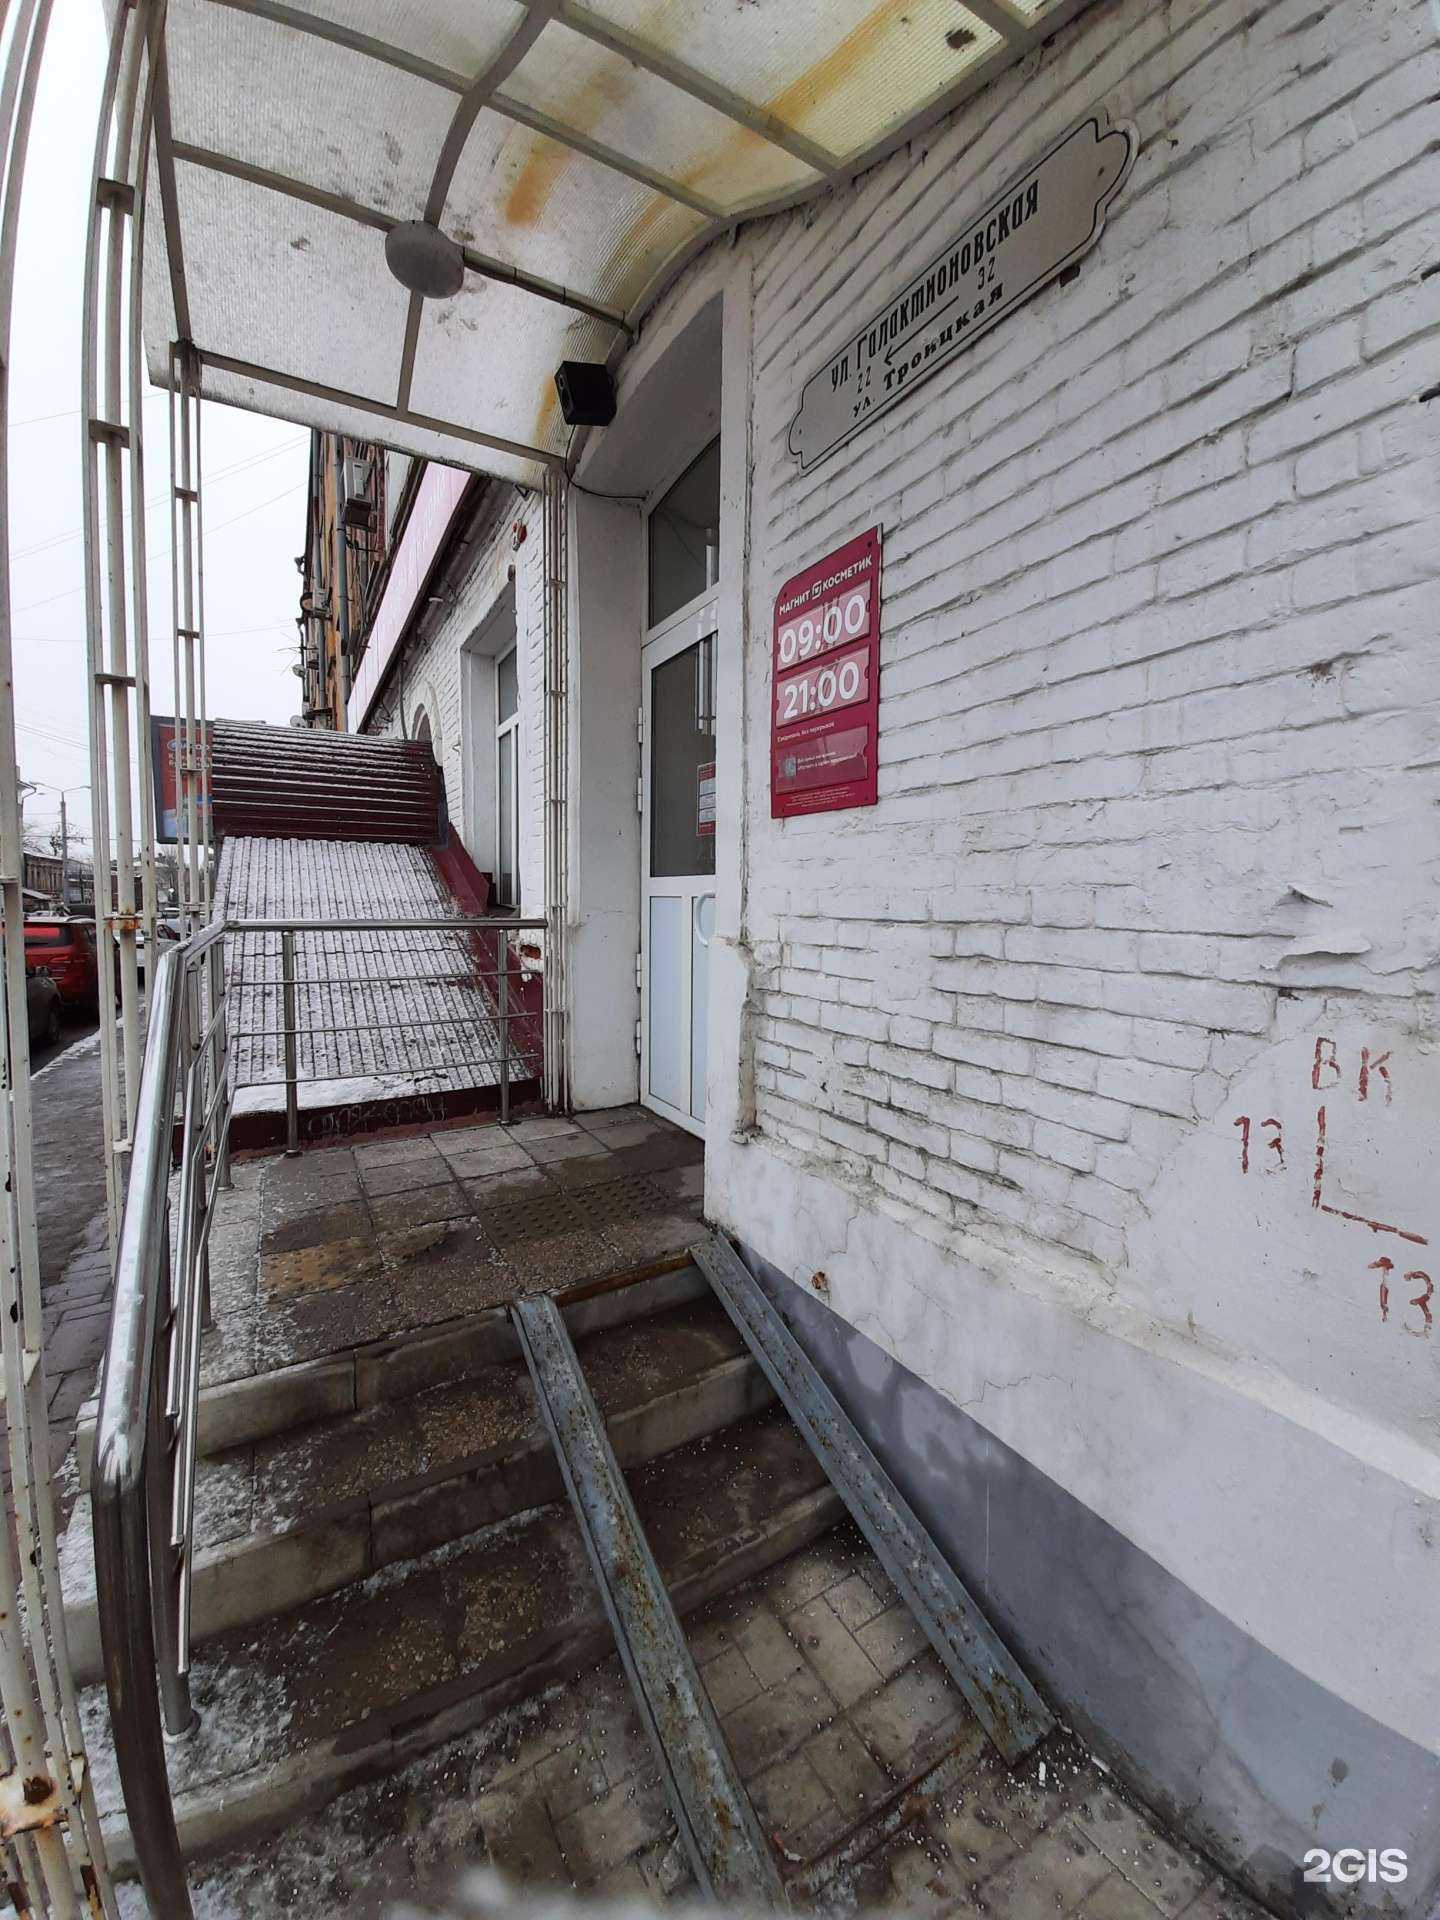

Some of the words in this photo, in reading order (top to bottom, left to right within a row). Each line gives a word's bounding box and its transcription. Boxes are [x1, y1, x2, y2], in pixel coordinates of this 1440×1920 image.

[857, 366, 871, 394] 22
[977, 257, 996, 290] 32
[883, 282, 1004, 392] Троицкая
[780, 590, 811, 615] МАГНИТ
[822, 554, 872, 592] КОСМЕТИК
[779, 594, 867, 665] 09:00
[783, 661, 860, 719] 21:00
[1233, 1116, 1288, 1175] 13
